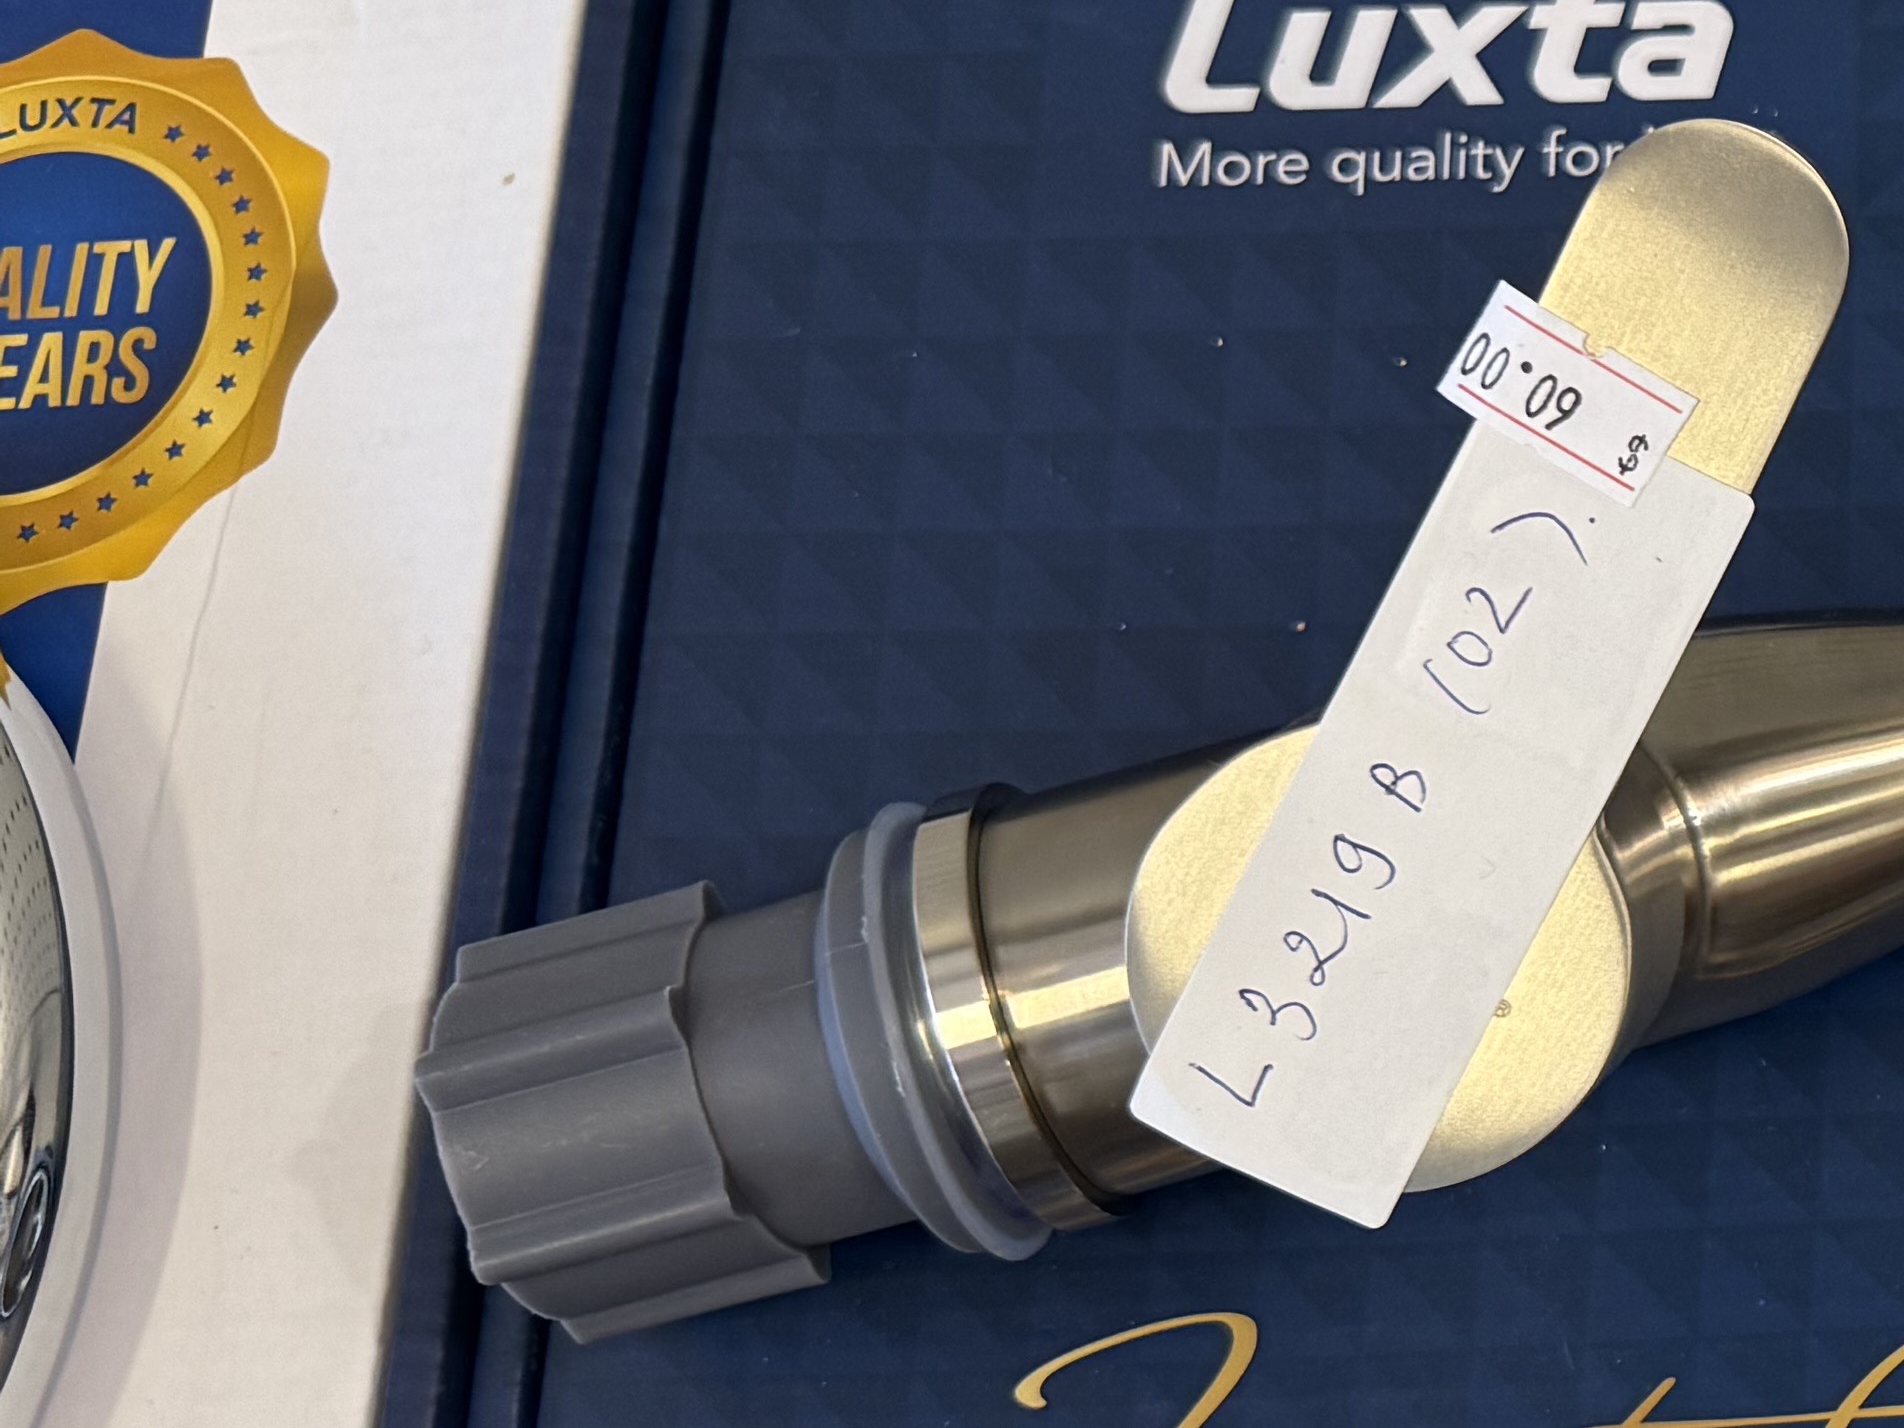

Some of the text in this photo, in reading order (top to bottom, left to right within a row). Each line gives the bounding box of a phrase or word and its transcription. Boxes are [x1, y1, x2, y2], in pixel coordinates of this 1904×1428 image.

[1158, 126, 1625, 196] More quality for
[1460, 332, 1583, 432] 60.00
